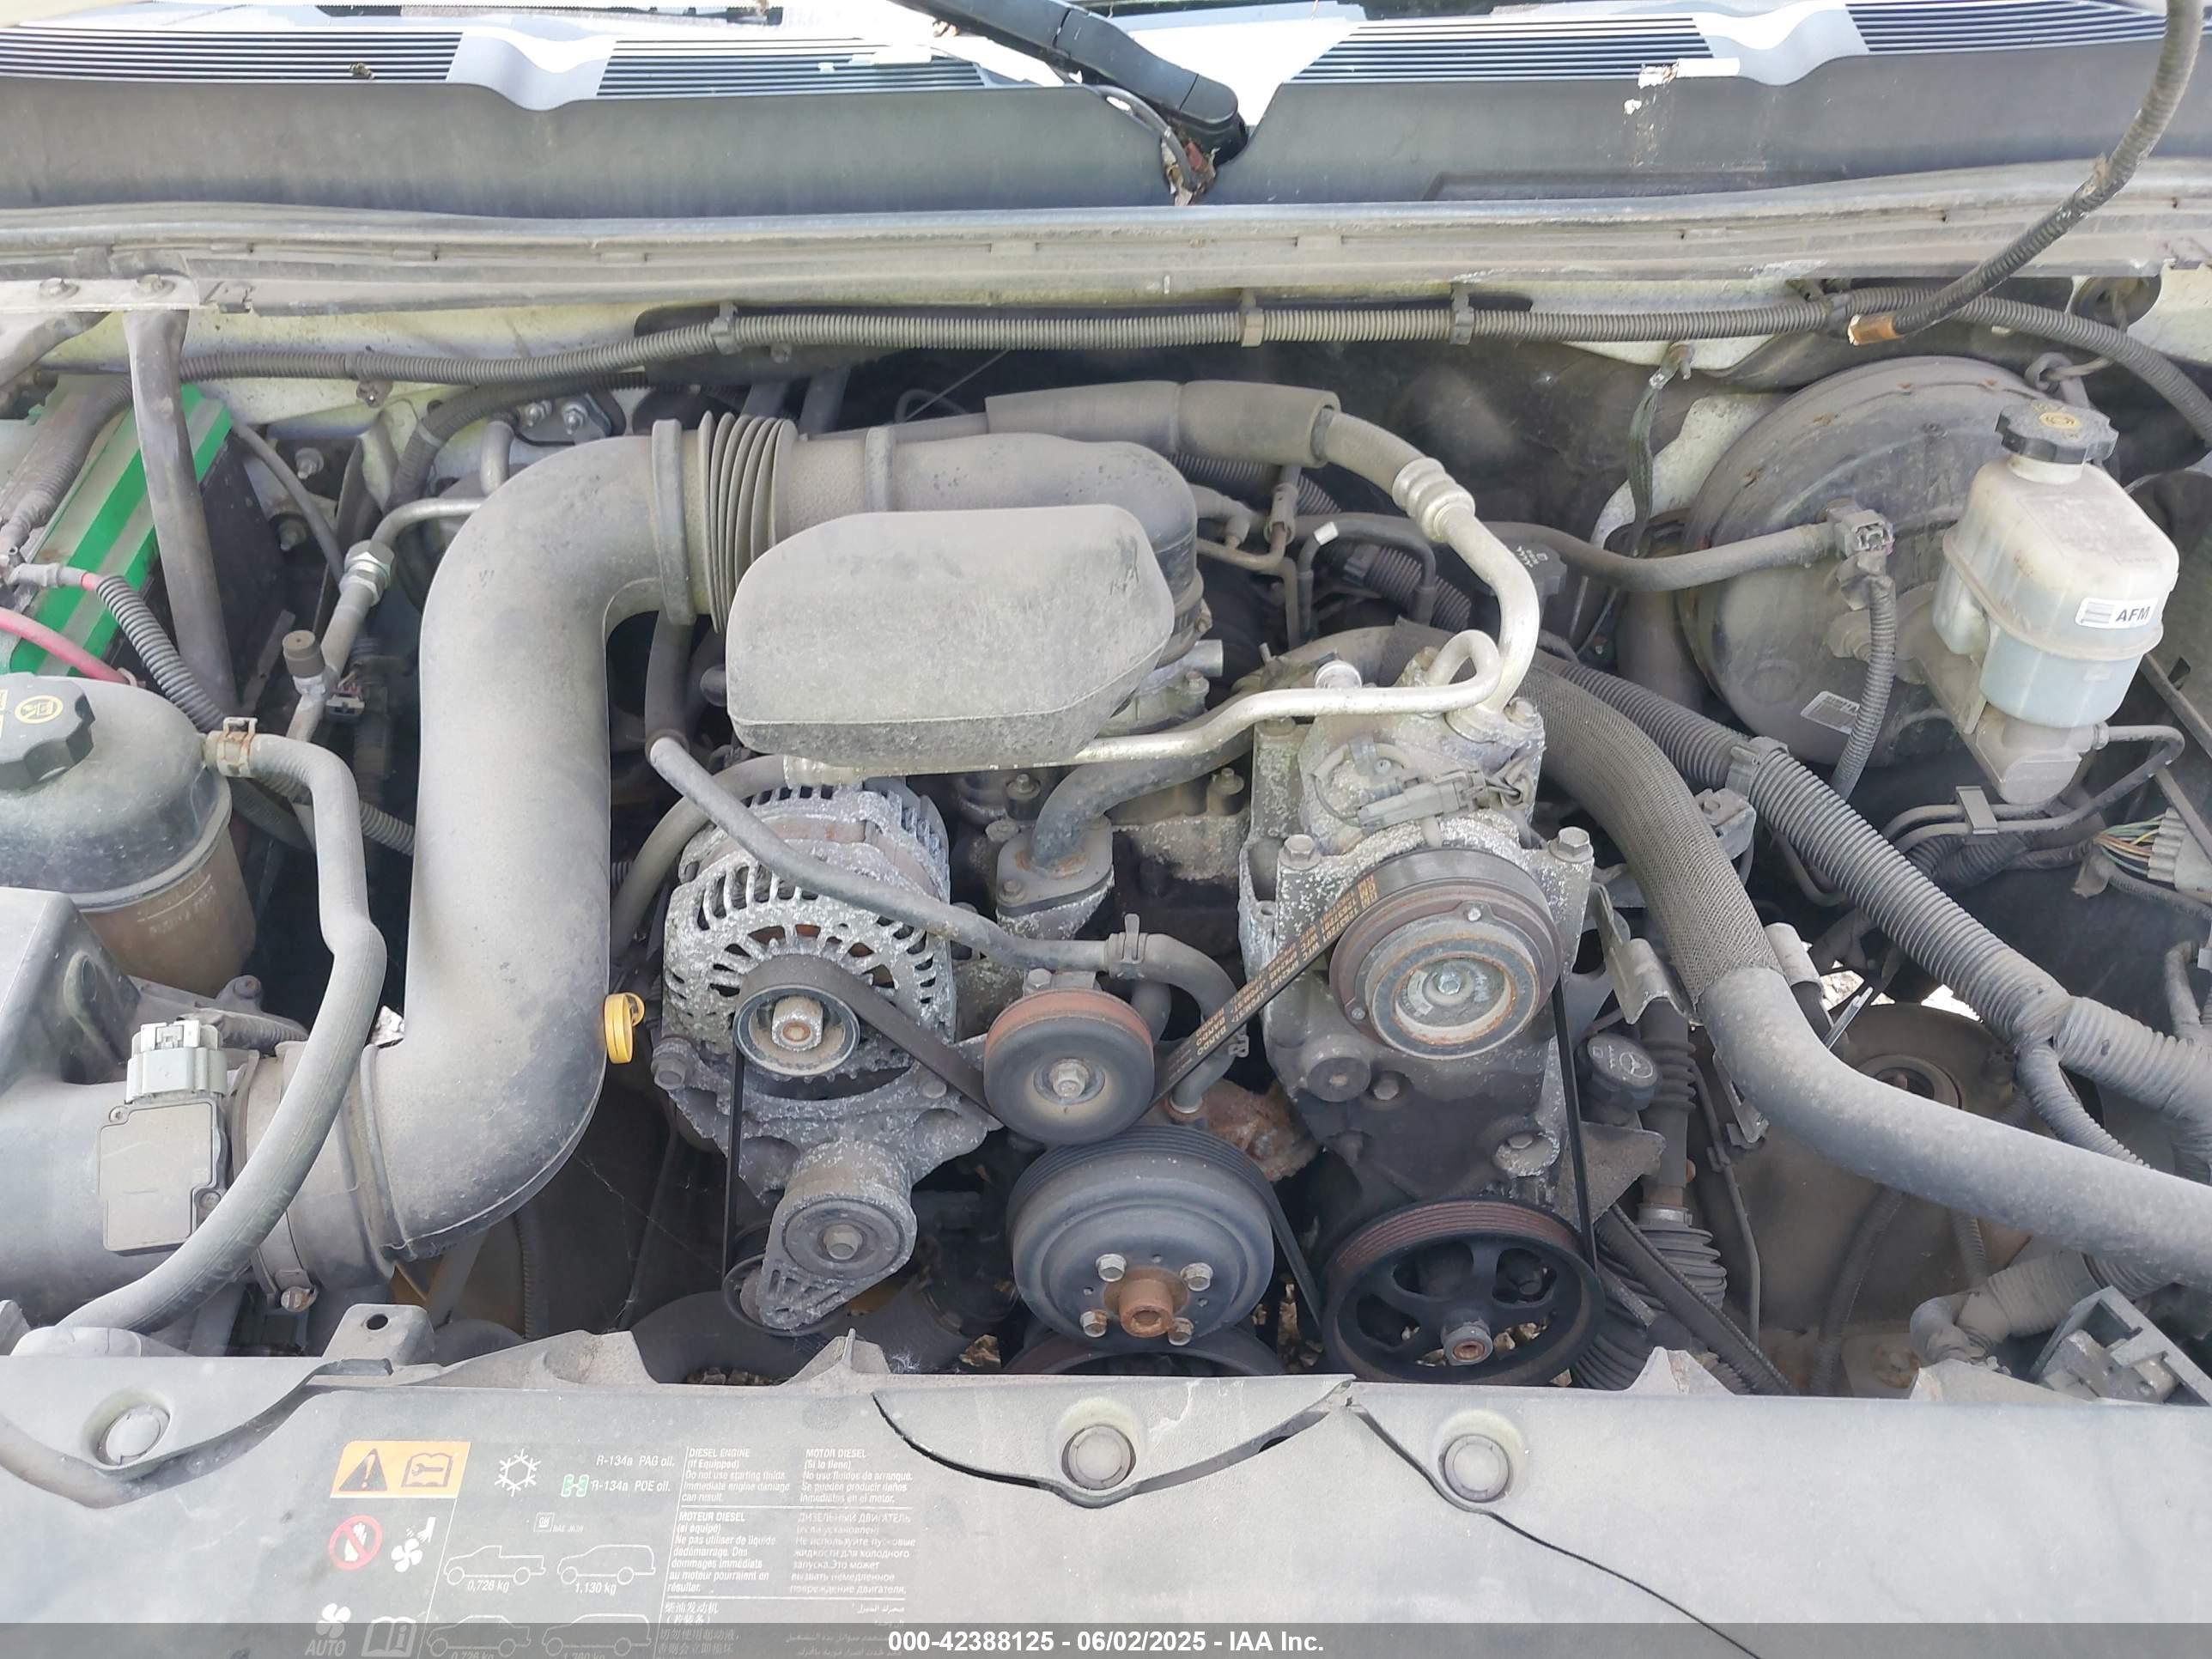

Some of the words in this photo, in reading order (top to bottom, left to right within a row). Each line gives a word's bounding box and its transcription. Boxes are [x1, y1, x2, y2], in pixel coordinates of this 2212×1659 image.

[2116, 606, 2150, 622] AFM
[1195, 1016, 1224, 1047] BANDO
[1196, 1024, 1226, 1056] BANDO
[689, 1448, 717, 1457] DIESEL
[720, 1448, 750, 1458] ENGINE
[805, 1449, 835, 1458] MOTOR
[838, 1449, 866, 1458] DIESEL
[596, 1455, 633, 1467] R-134a
[639, 1455, 659, 1467] PAG
[661, 1456, 674, 1467] oil.
[699, 1459, 739, 1469] Equipped)
[685, 1470, 696, 1480] Do
[730, 1472, 761, 1480] starting
[804, 1471, 814, 1480] No
[862, 1471, 872, 1480] de
[592, 1480, 629, 1491] R-134a
[635, 1480, 655, 1491] POE
[657, 1481, 671, 1492] oil.
[757, 1483, 789, 1492] damage
[802, 1482, 812, 1491] Se
[814, 1484, 843, 1492] pueden
[846, 1483, 879, 1492] producir
[869, 1495, 895, 1504] motor.
[679, 1511, 714, 1522] MOTEUR
[716, 1512, 745, 1522] DIESEL
[675, 1534, 686, 1544] Ne
[689, 1537, 703, 1546] pas
[736, 1535, 746, 1545] de
[732, 1547, 748, 1556] Des
[860, 1550, 909, 1559] холодного
[672, 1559, 716, 1570] dommages
[849, 1561, 879, 1570] может
[669, 1571, 679, 1580] au
[682, 1571, 711, 1581] moteur
[714, 1571, 757, 1582] pourraient
[759, 1572, 769, 1581] en
[497, 1580, 509, 1594] kg
[605, 1582, 617, 1595] kg
[666, 1583, 701, 1593] résulter.
[856, 1586, 906, 1595] двигателя.
[304, 1638, 346, 1657] AUTO
